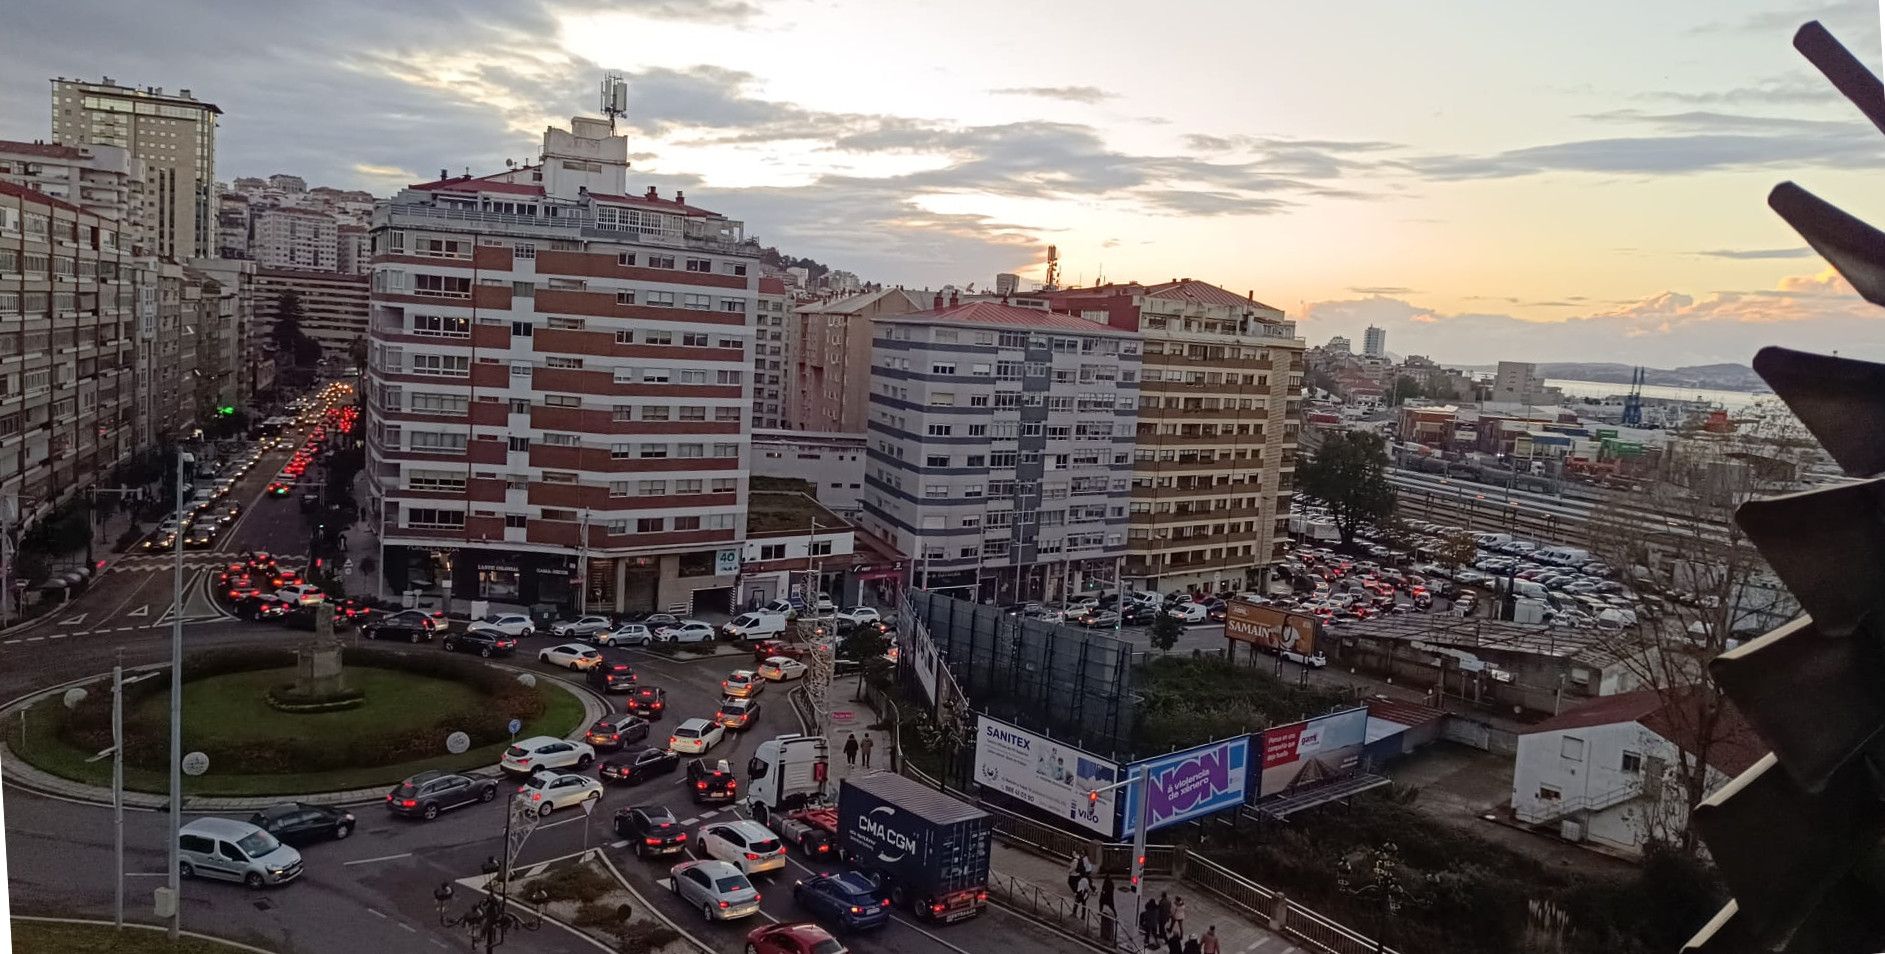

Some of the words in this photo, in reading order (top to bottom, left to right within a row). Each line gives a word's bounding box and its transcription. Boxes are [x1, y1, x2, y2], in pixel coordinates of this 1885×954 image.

[720, 552, 735, 562] 40
[1229, 620, 1269, 638] SAMAIN
[987, 726, 1030, 750] SANITEX
[1147, 744, 1229, 827] NON
[1174, 769, 1210, 788] violencia
[1168, 791, 1179, 801] de
[858, 814, 885, 841] CMA
[887, 829, 916, 856] CGM
